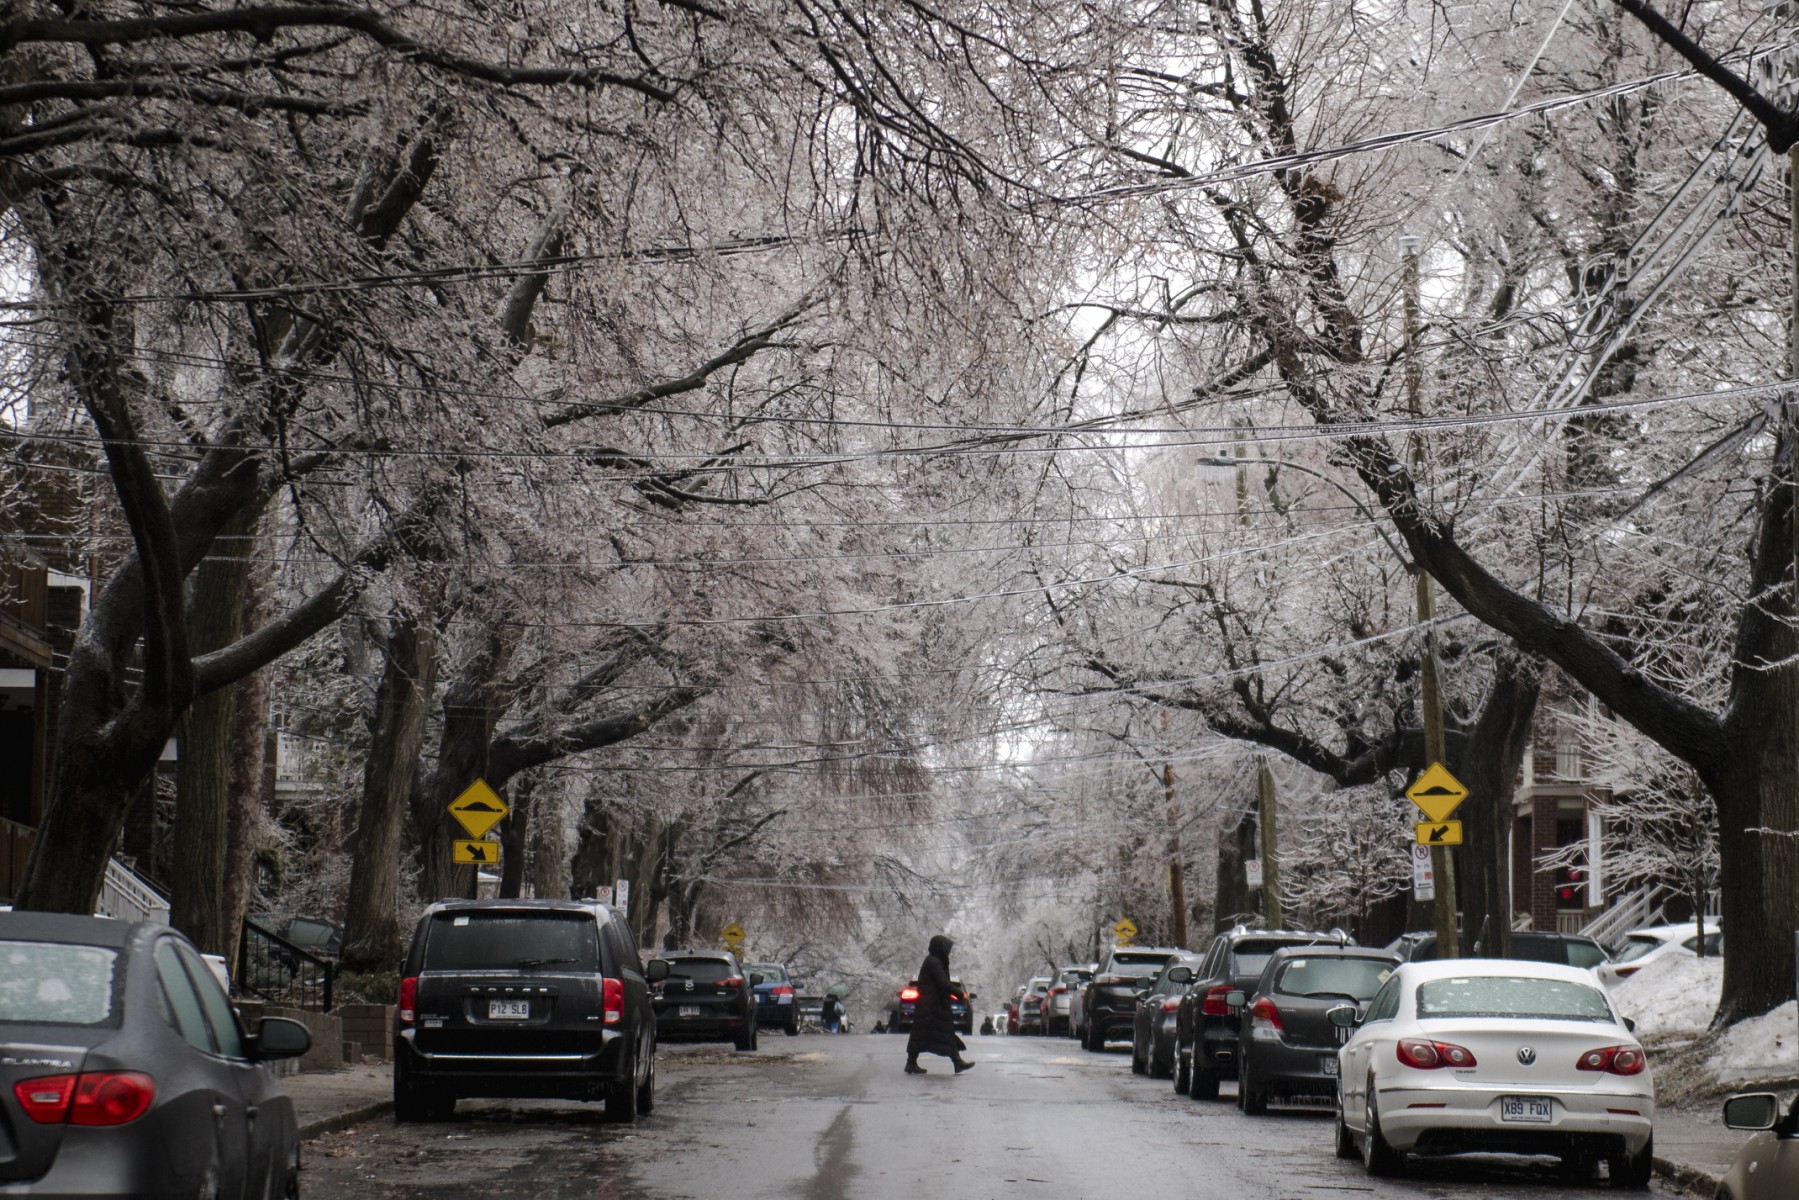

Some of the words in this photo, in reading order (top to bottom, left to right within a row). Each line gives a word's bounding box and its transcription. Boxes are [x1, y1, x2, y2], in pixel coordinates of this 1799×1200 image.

[490, 1003, 507, 1014] P12
[511, 1004, 527, 1015] SLB
[1504, 1102, 1524, 1115] X89
[1529, 1102, 1549, 1116] FQX
